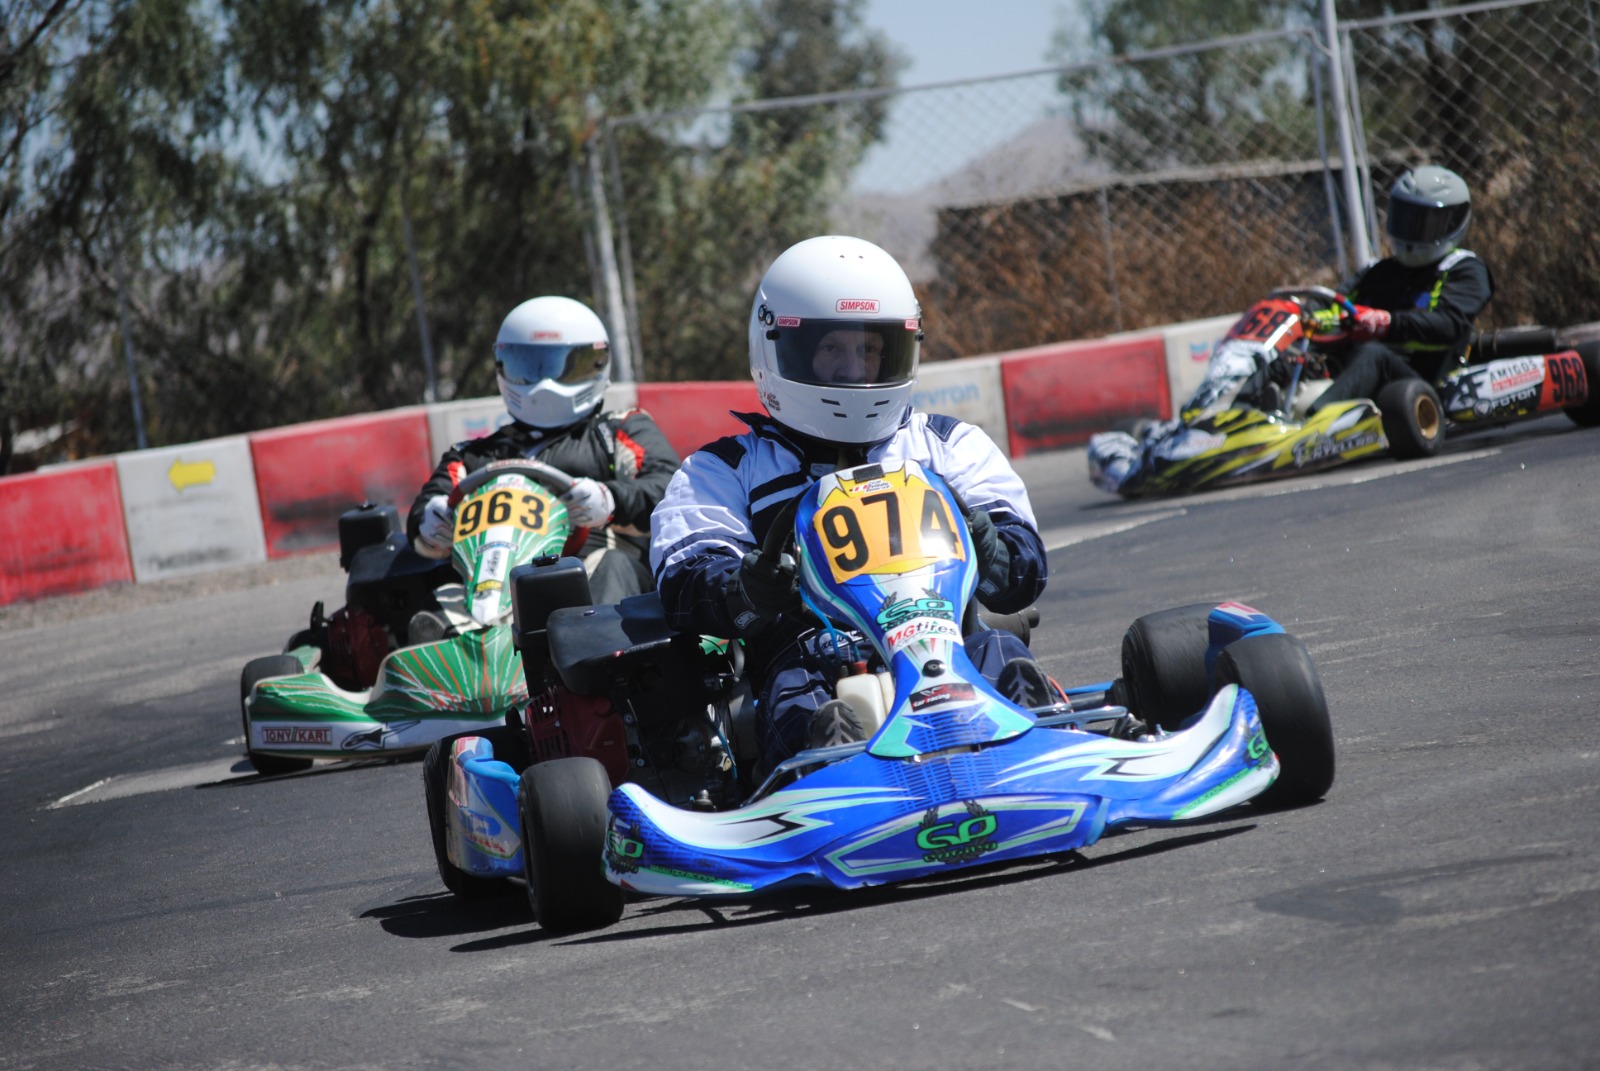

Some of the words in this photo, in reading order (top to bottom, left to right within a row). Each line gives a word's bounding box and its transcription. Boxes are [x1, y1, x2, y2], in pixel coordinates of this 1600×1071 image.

[840, 301, 877, 311] SIMPSON
[779, 318, 798, 326] SIMPSON
[1490, 358, 1537, 381] AMIGOS
[1548, 356, 1586, 404] 968
[911, 383, 980, 408] evron
[1491, 388, 1537, 409] FOTON
[459, 490, 545, 536] 963
[822, 490, 958, 572] 974
[265, 728, 291, 742] TONY
[298, 728, 330, 743] KART
